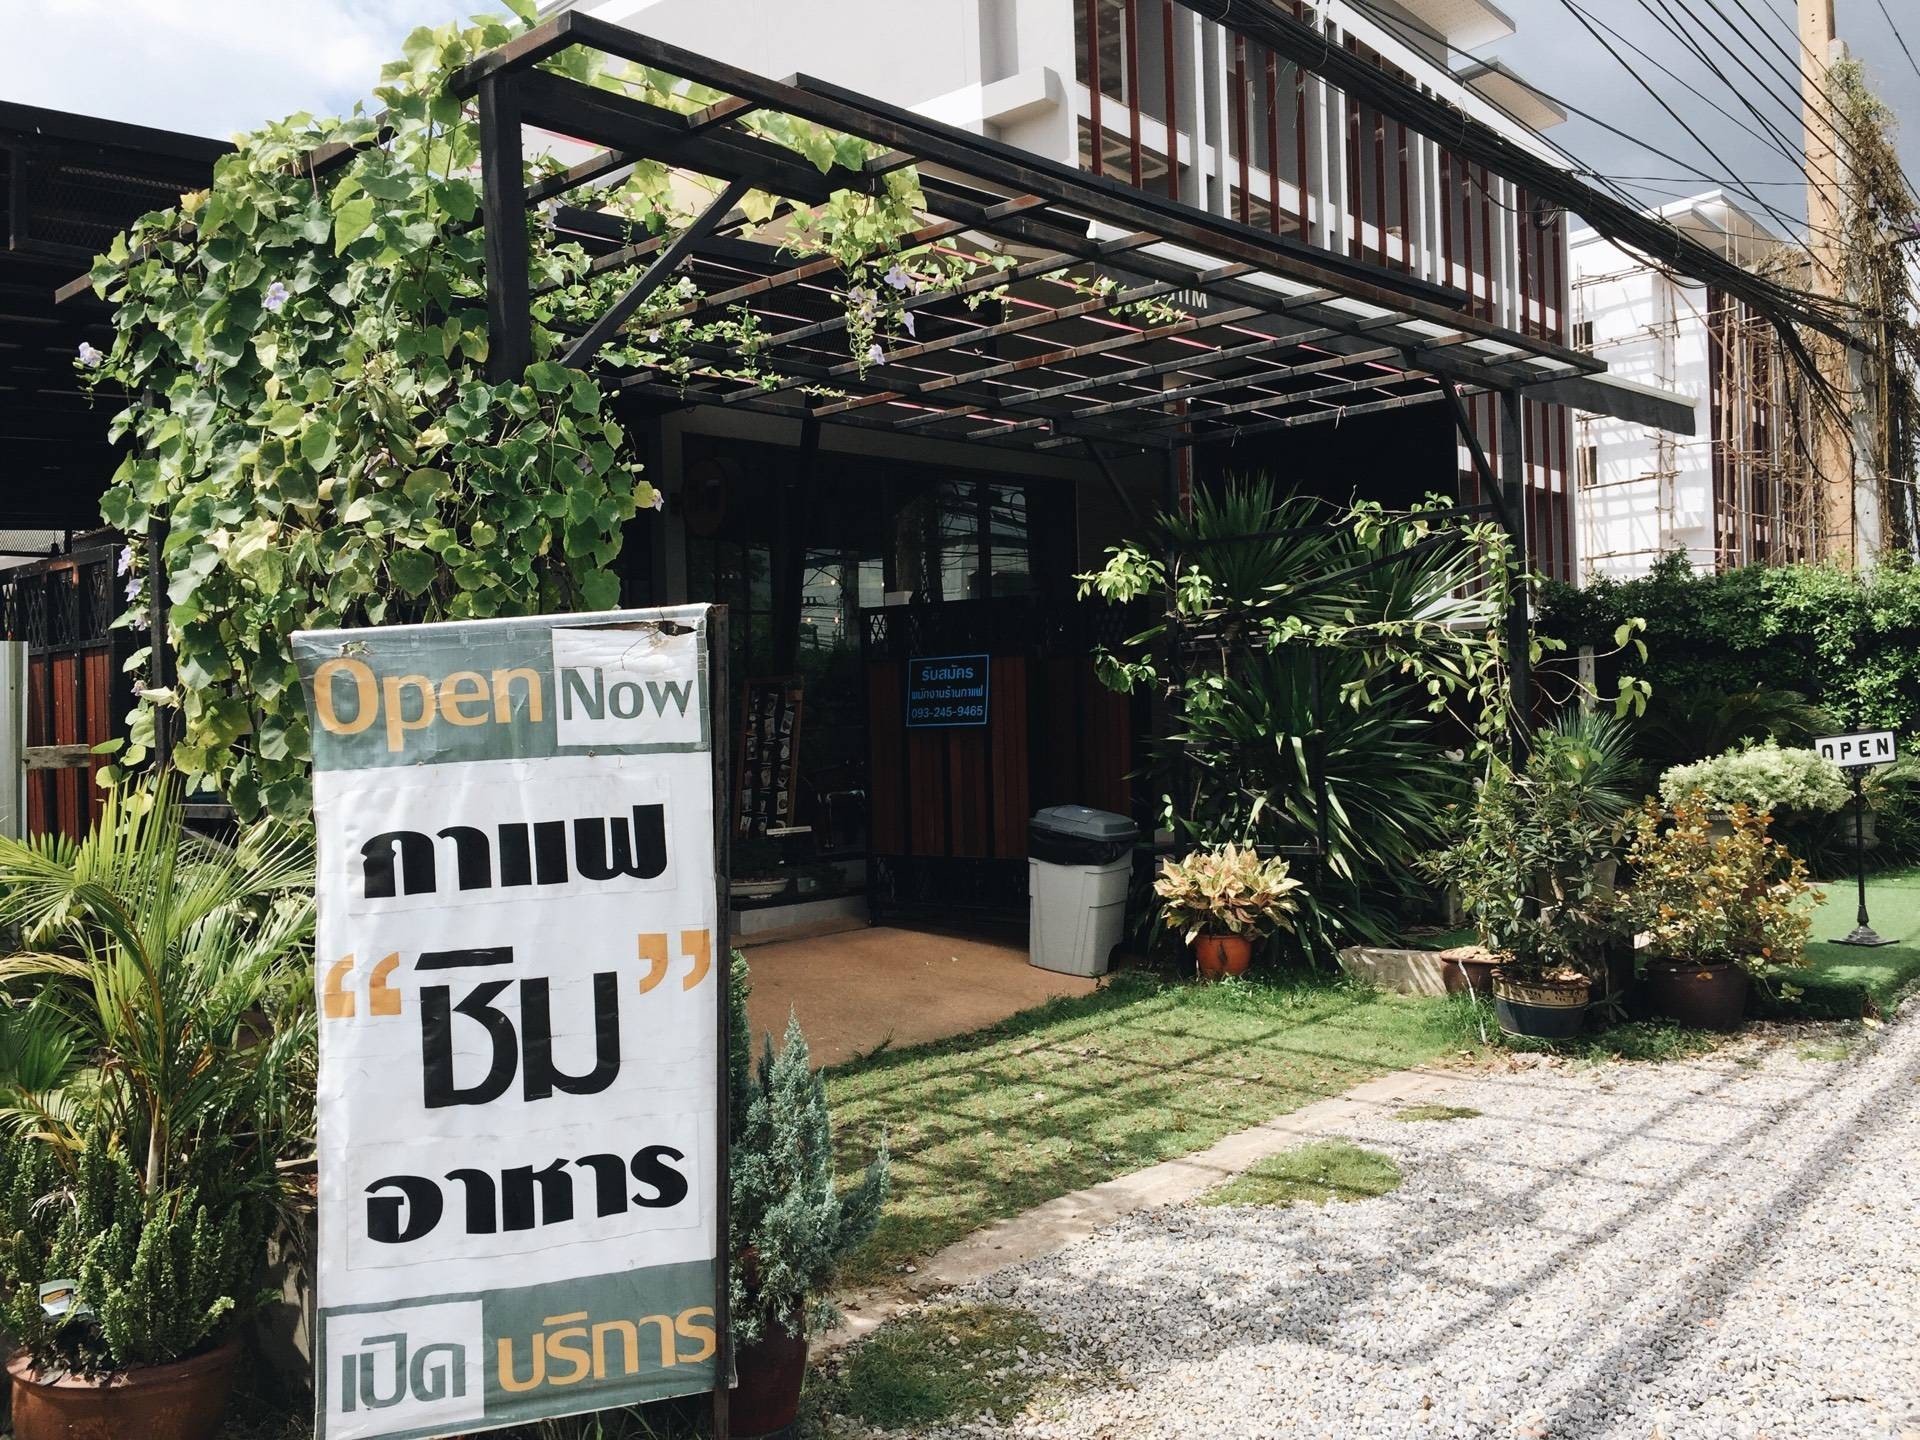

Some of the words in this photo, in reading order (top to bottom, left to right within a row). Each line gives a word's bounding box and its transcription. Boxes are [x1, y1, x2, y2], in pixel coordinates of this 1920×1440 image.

[313, 657, 543, 752] Open
[561, 667, 693, 721] Now
[911, 705, 983, 719] 093-245-9465
[921, 664, 974, 681] รับสมัคร
[1821, 738, 1889, 761] OPEN
[360, 803, 668, 899] กาแฟ
[364, 1144, 689, 1244] อาหาร
[341, 1332, 467, 1413] เปิด
[497, 1305, 717, 1393] บริการ
